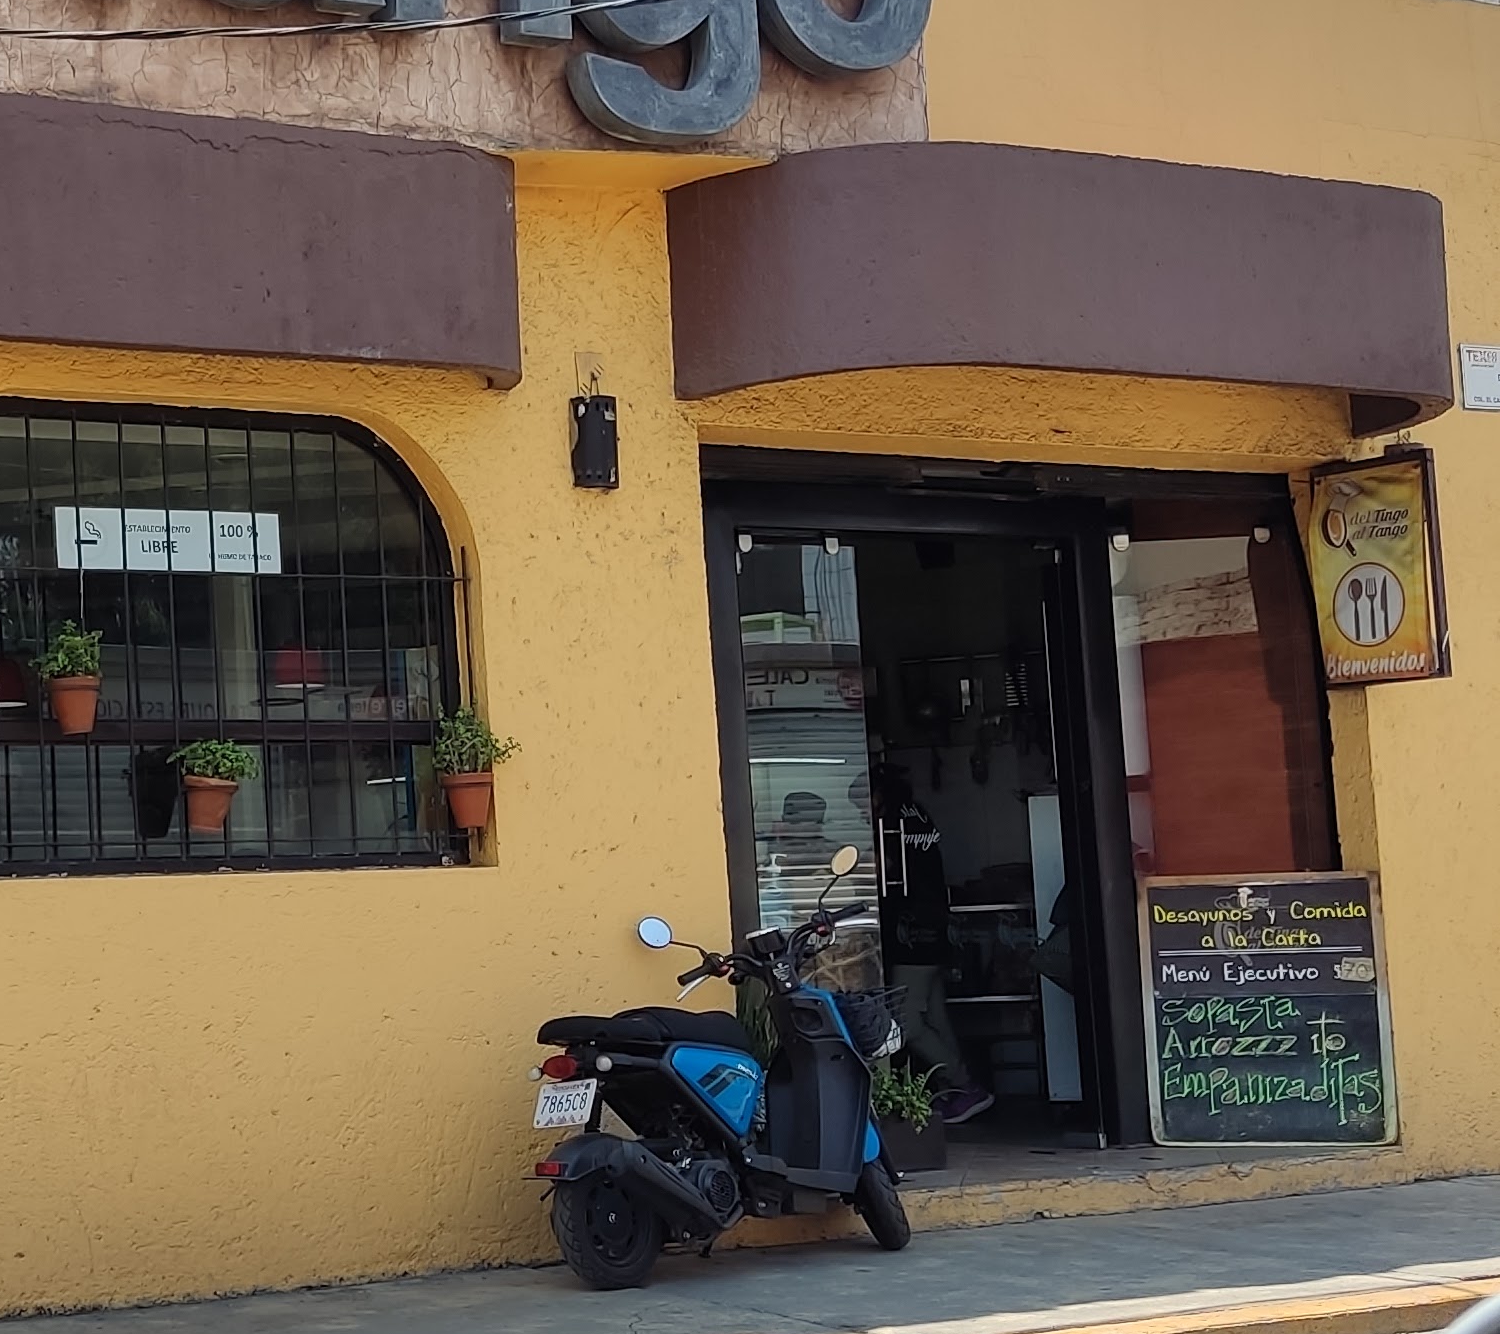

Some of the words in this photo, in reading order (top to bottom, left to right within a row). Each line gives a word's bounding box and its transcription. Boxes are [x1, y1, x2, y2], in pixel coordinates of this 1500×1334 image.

[1350, 510, 1372, 525] del
[1373, 508, 1409, 525] Tingo
[219, 525, 243, 538] 100
[1351, 525, 1367, 540] al
[1368, 524, 1409, 540] Tango
[141, 540, 178, 553] LIBRE
[1153, 905, 1253, 927] Desayunos
[1266, 908, 1276, 924] y
[1290, 901, 1367, 919] Comida
[1201, 936, 1214, 948] a
[1229, 932, 1247, 947] la
[1261, 929, 1322, 947] Carta
[1162, 964, 1210, 983] Menú
[1223, 962, 1319, 985] Ejecutivo
[1162, 1027, 1298, 1059] Arrozzz
